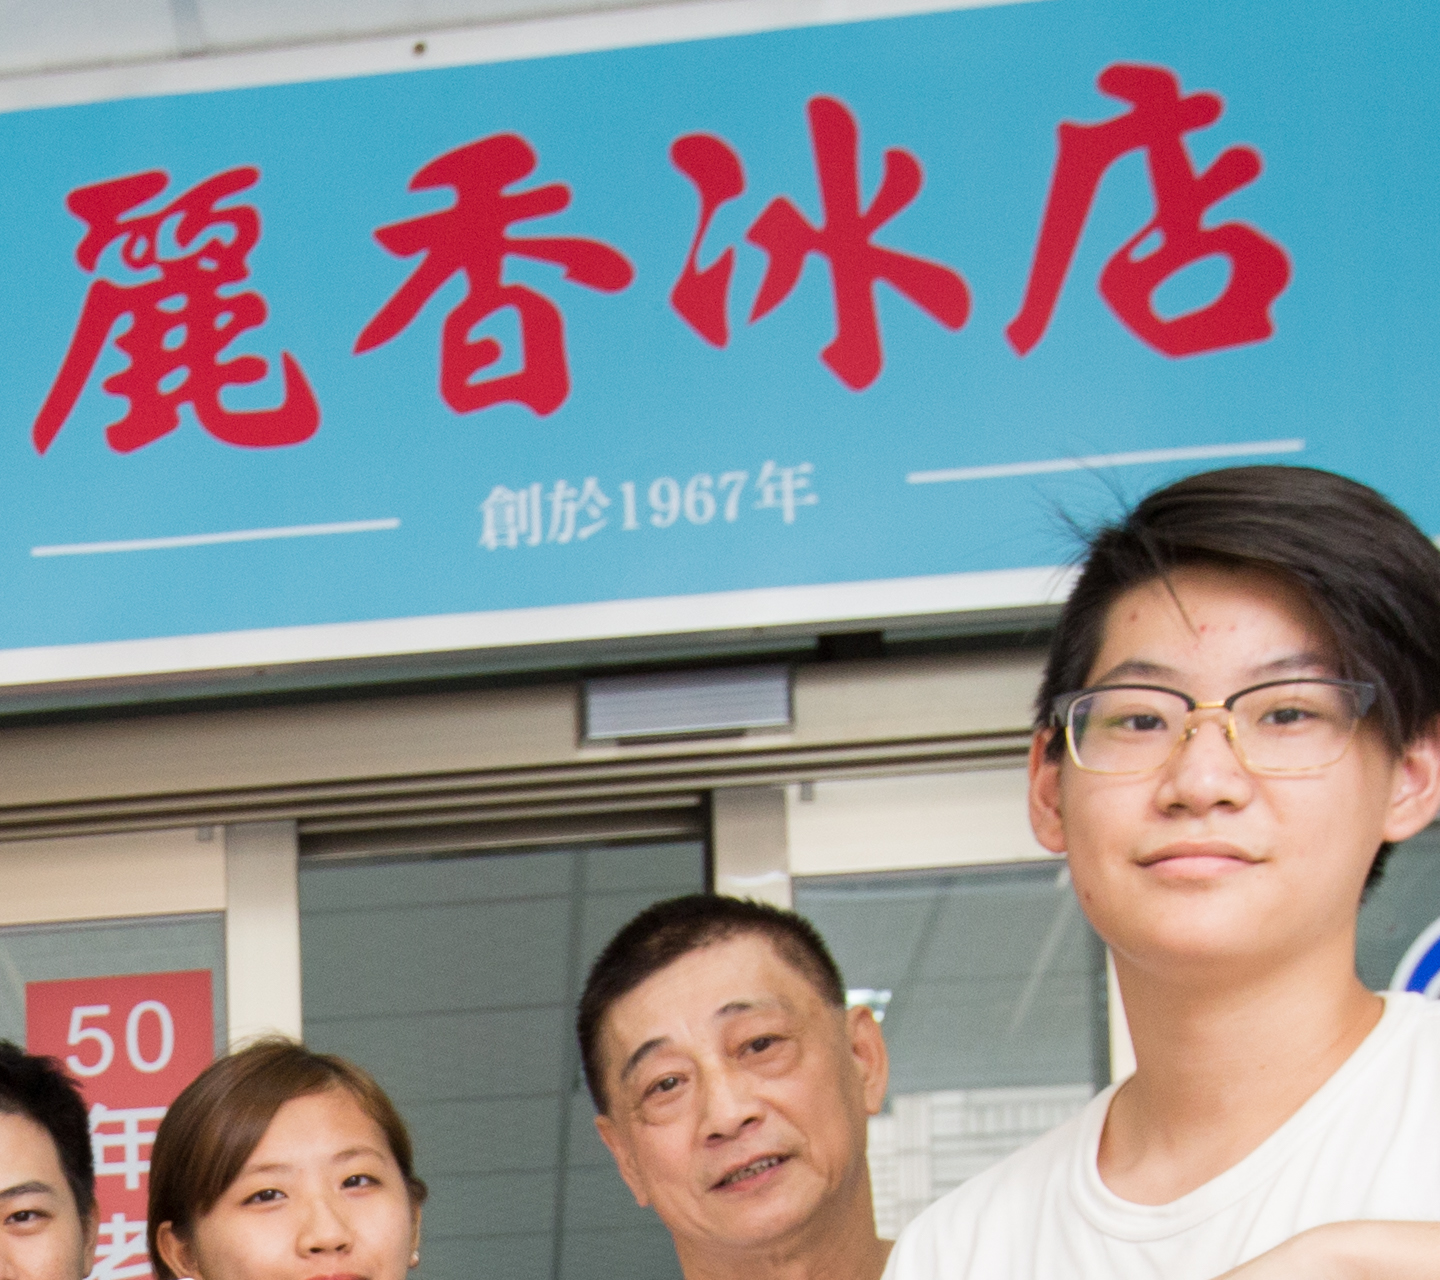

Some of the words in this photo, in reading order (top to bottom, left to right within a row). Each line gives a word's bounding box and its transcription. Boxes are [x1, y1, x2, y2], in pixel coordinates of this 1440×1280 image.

[30, 62, 1293, 458] 麗香冰店
[480, 459, 820, 550] 創於1967年
